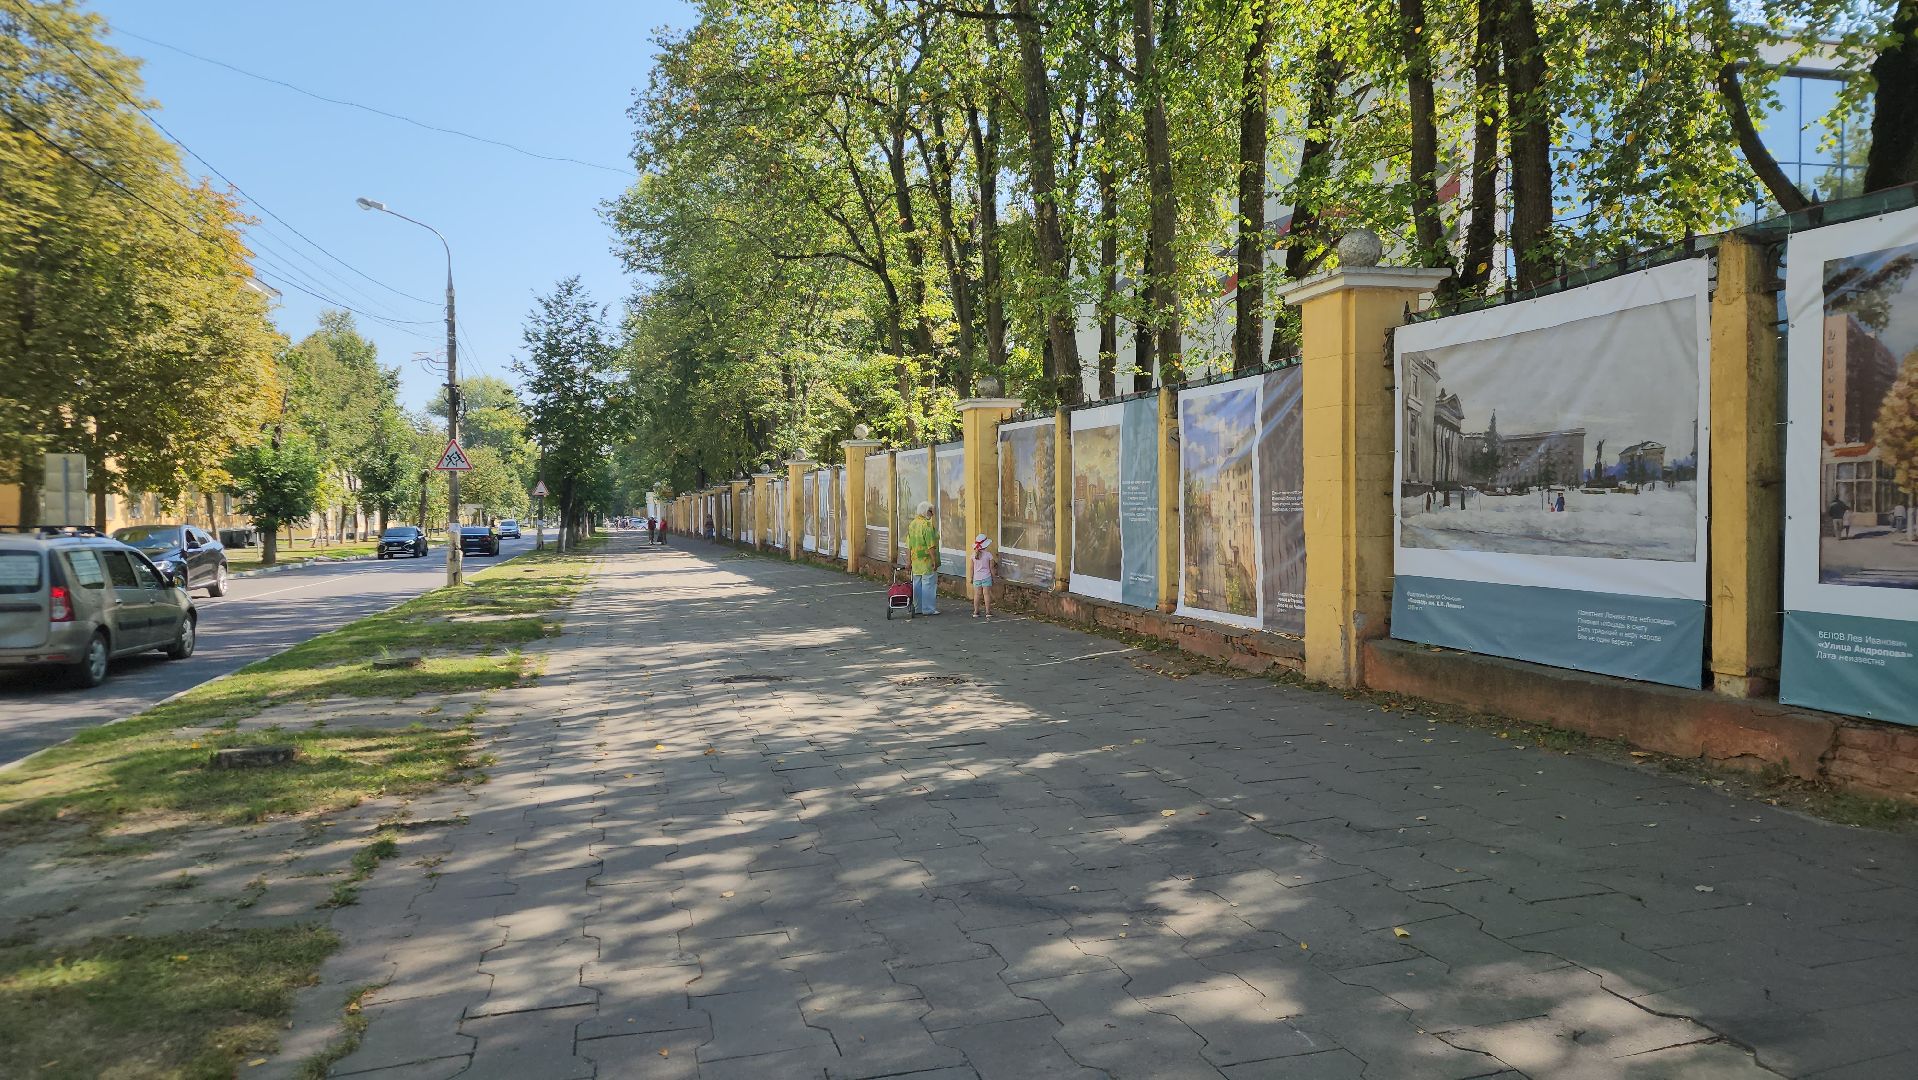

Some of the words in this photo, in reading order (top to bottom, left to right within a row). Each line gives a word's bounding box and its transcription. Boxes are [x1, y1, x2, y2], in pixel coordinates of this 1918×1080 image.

[1818, 631, 1845, 641] БЕЛОВ
[1847, 634, 1862, 643] Лев
[1865, 636, 1907, 648] Иванович
[1816, 650, 1836, 660] Дата
[1838, 655, 1885, 666] неизвестна
[1818, 641, 1852, 653] «Улица
[1854, 645, 1913, 658] Андропова»
